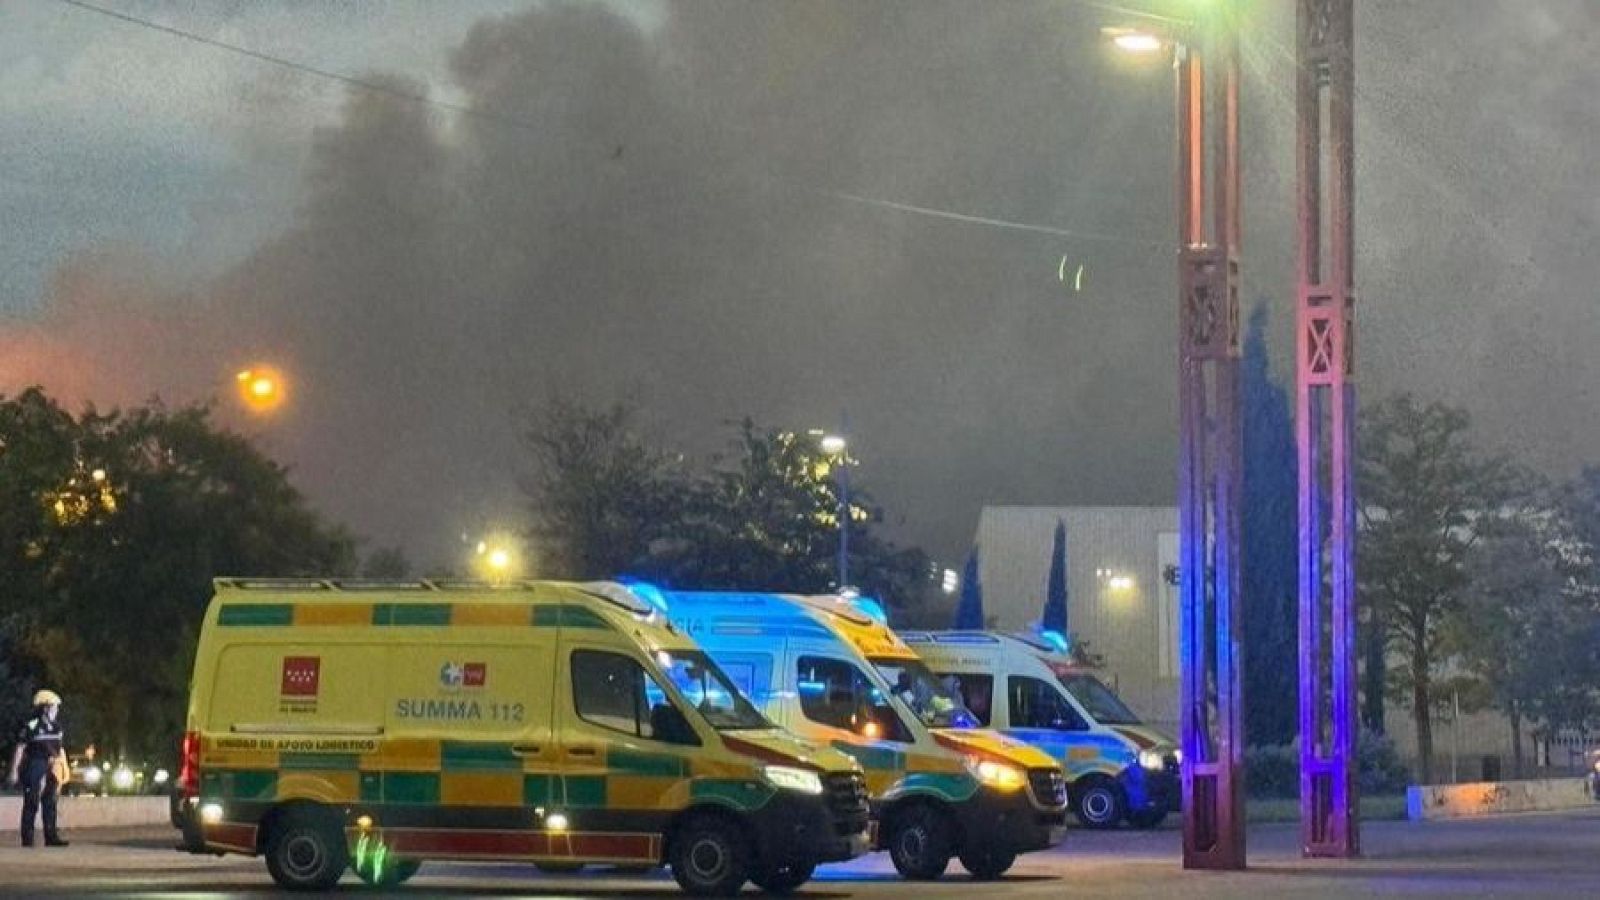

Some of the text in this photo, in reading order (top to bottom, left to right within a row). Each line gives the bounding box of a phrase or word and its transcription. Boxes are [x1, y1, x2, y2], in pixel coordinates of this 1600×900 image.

[396, 698, 525, 721] SUMMA 112
[278, 739, 314, 750] APOYO
